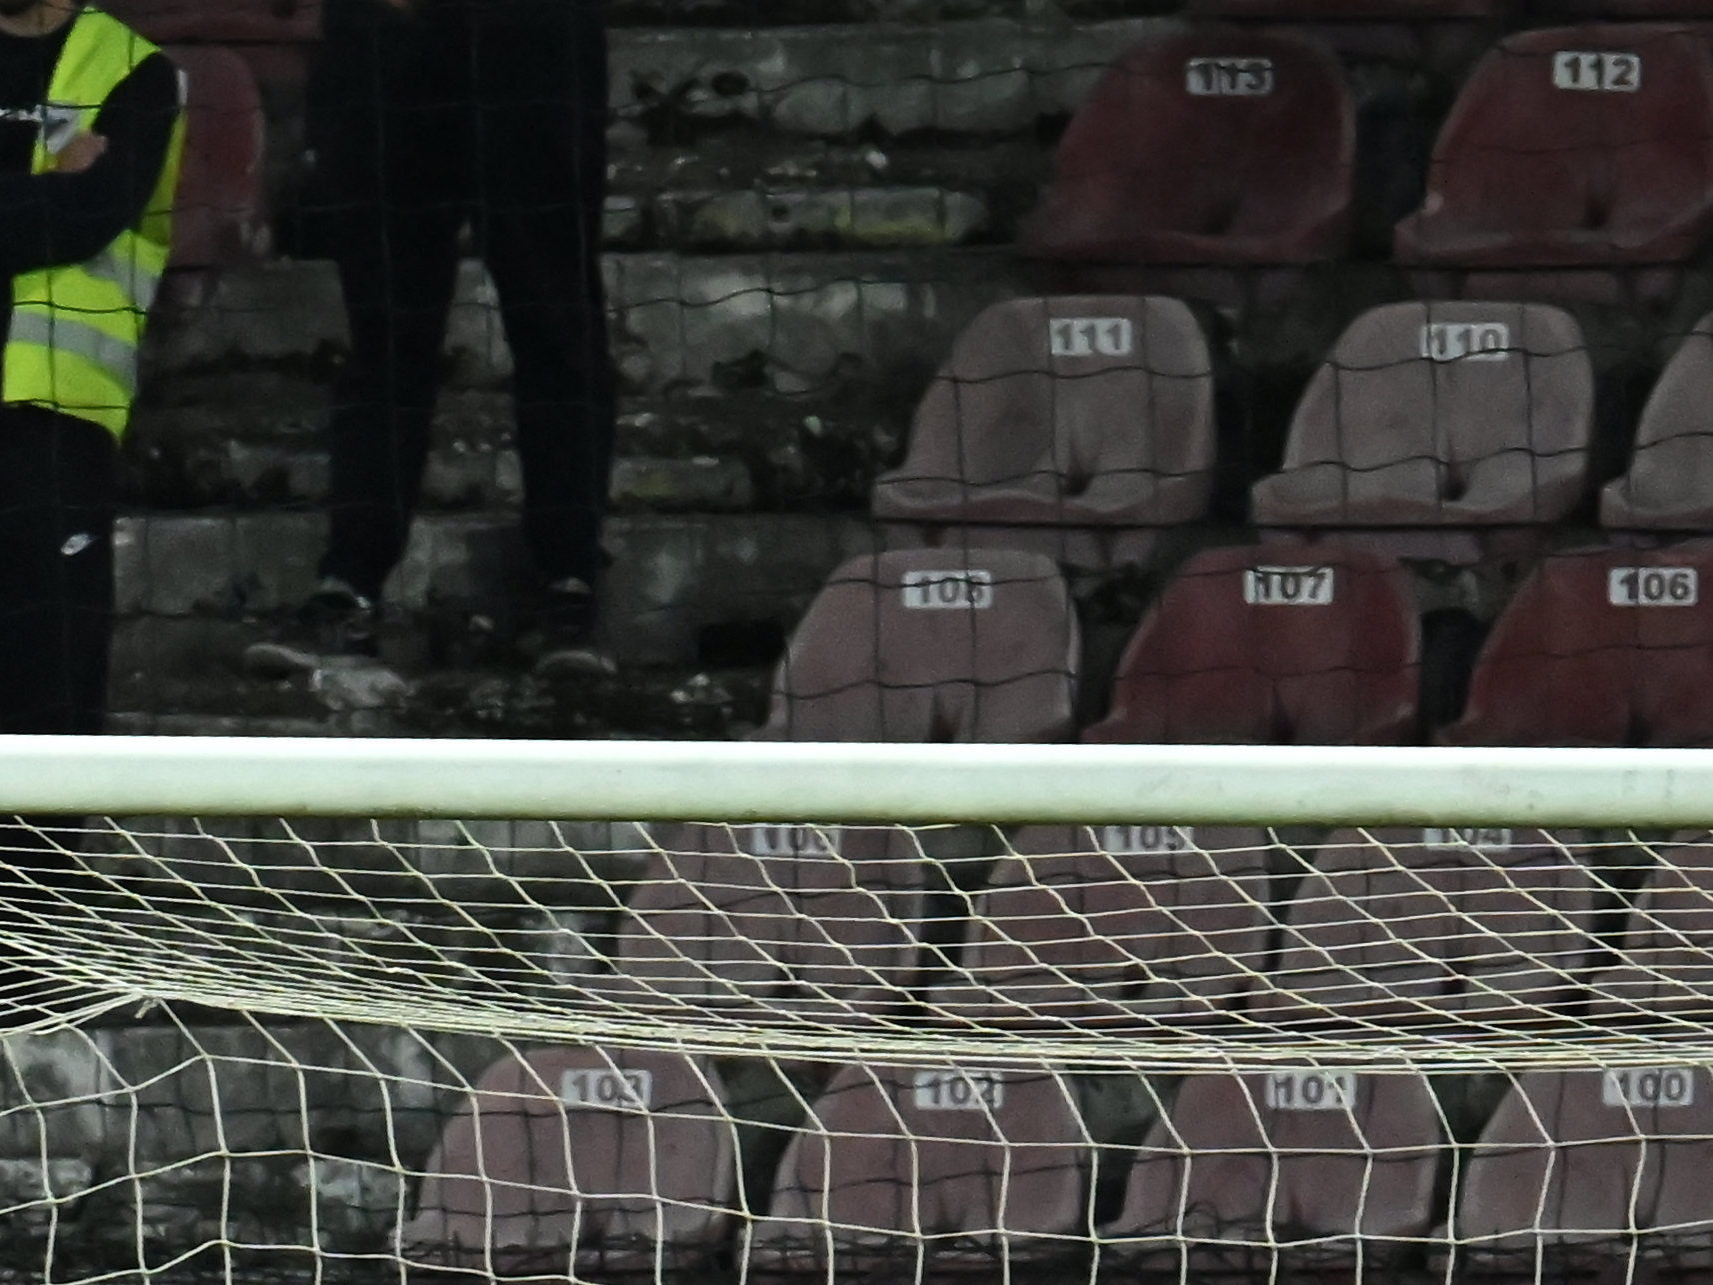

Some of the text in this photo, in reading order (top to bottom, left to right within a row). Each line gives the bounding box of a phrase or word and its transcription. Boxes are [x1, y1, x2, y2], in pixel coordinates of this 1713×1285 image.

[1562, 56, 1631, 87] 112
[1056, 321, 1121, 353] 111
[1429, 326, 1503, 357] 110
[1255, 570, 1325, 600] 107
[1619, 572, 1690, 602] 106
[1615, 1072, 1688, 1103] 100
